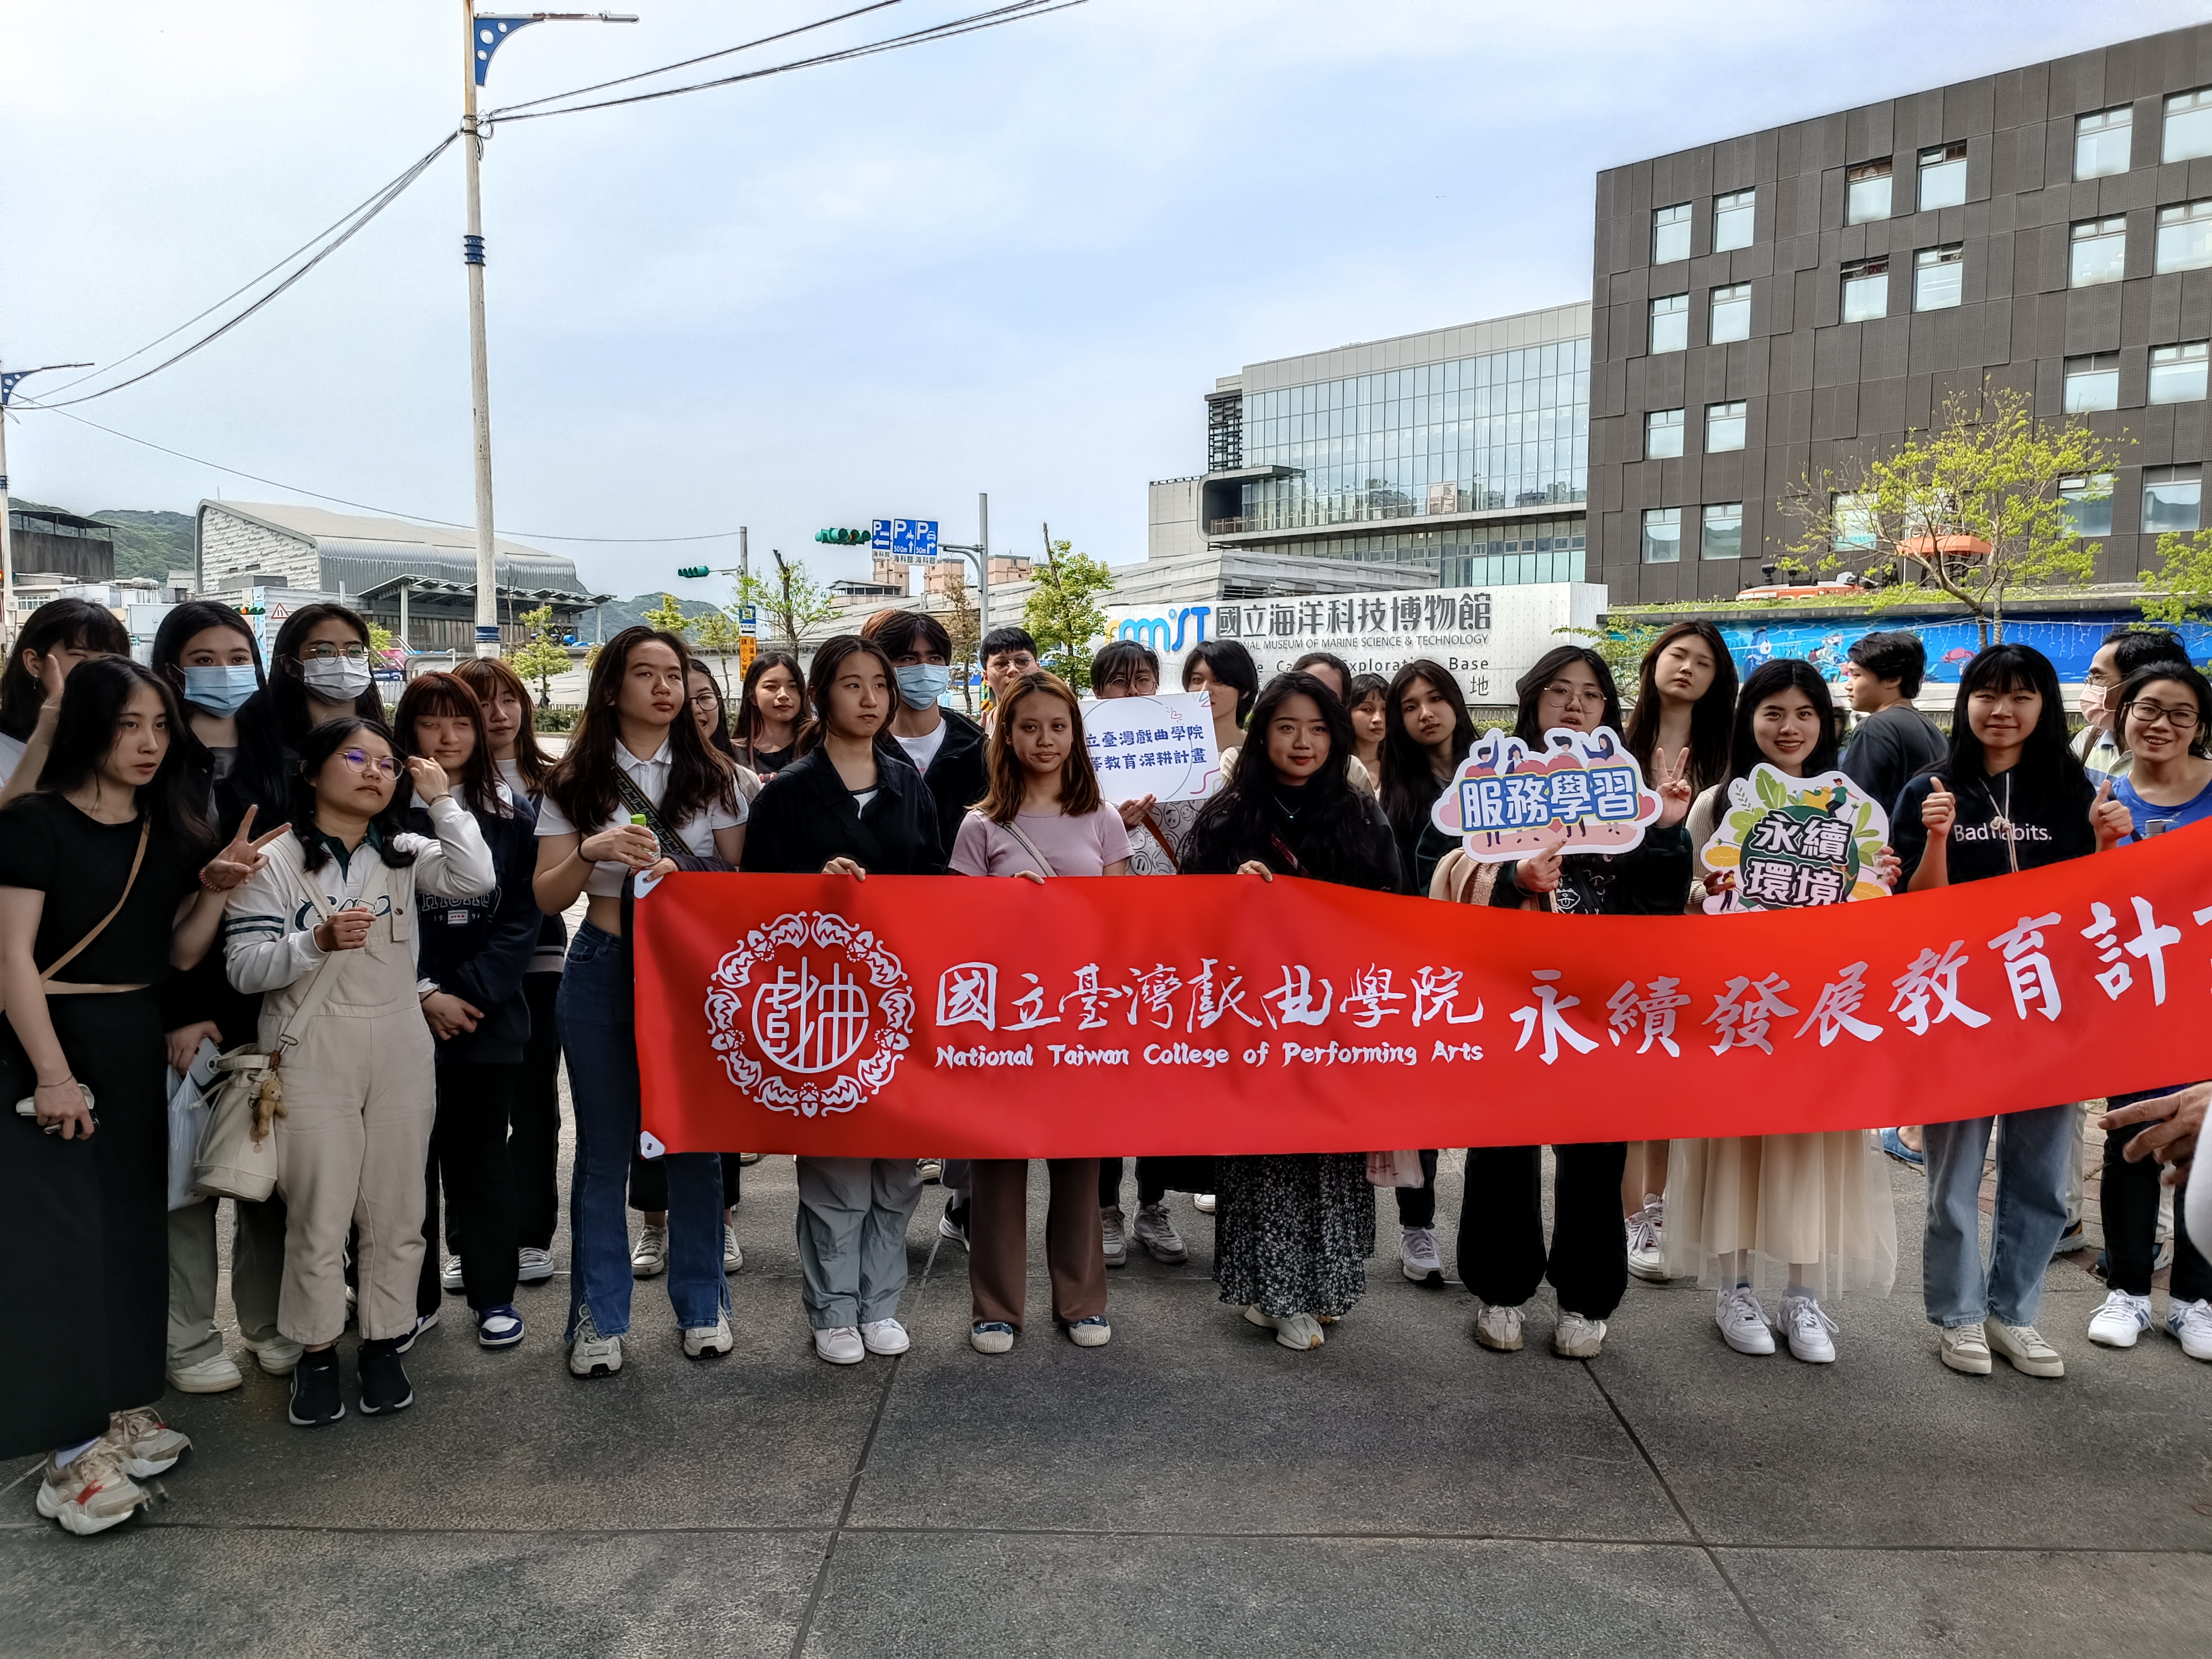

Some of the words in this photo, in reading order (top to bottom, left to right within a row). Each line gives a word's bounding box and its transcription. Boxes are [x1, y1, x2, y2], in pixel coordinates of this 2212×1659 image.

[873, 521, 882, 535] P
[894, 520, 907, 539] P
[916, 521, 929, 540] P
[893, 555, 913, 563] 海科館
[1217, 593, 1491, 637] 國立海洋科技博物館
[1264, 639, 1303, 649] MUSEUM
[1306, 639, 1318, 648] OF
[1322, 638, 1358, 648] MARINE
[1361, 636, 1401, 646] SCIENCE
[1405, 636, 1412, 646] &
[1417, 634, 1489, 645] TECHNOLOGY
[1341, 657, 1413, 673] xplora
[1449, 657, 1489, 670] Base
[1086, 724, 1204, 748] 立臺灣戲曲學院
[1090, 748, 1207, 772] 等教育深耕計畫
[1462, 769, 1635, 828] 服務學習
[1754, 813, 1849, 862] 永續
[1954, 822, 1989, 842] Bad
[1746, 860, 1840, 906] 環境
[1510, 896, 2212, 1065] 永續發展教育計
[935, 958, 1484, 1033] 國立臺灣戲曲學院
[935, 1044, 1033, 1068] National
[1047, 1044, 1129, 1067] Taiwan
[1143, 1042, 1229, 1068] College
[1243, 1041, 1270, 1067] of
[1282, 1040, 1417, 1067] Performing
[1431, 1040, 1484, 1063] Arts
